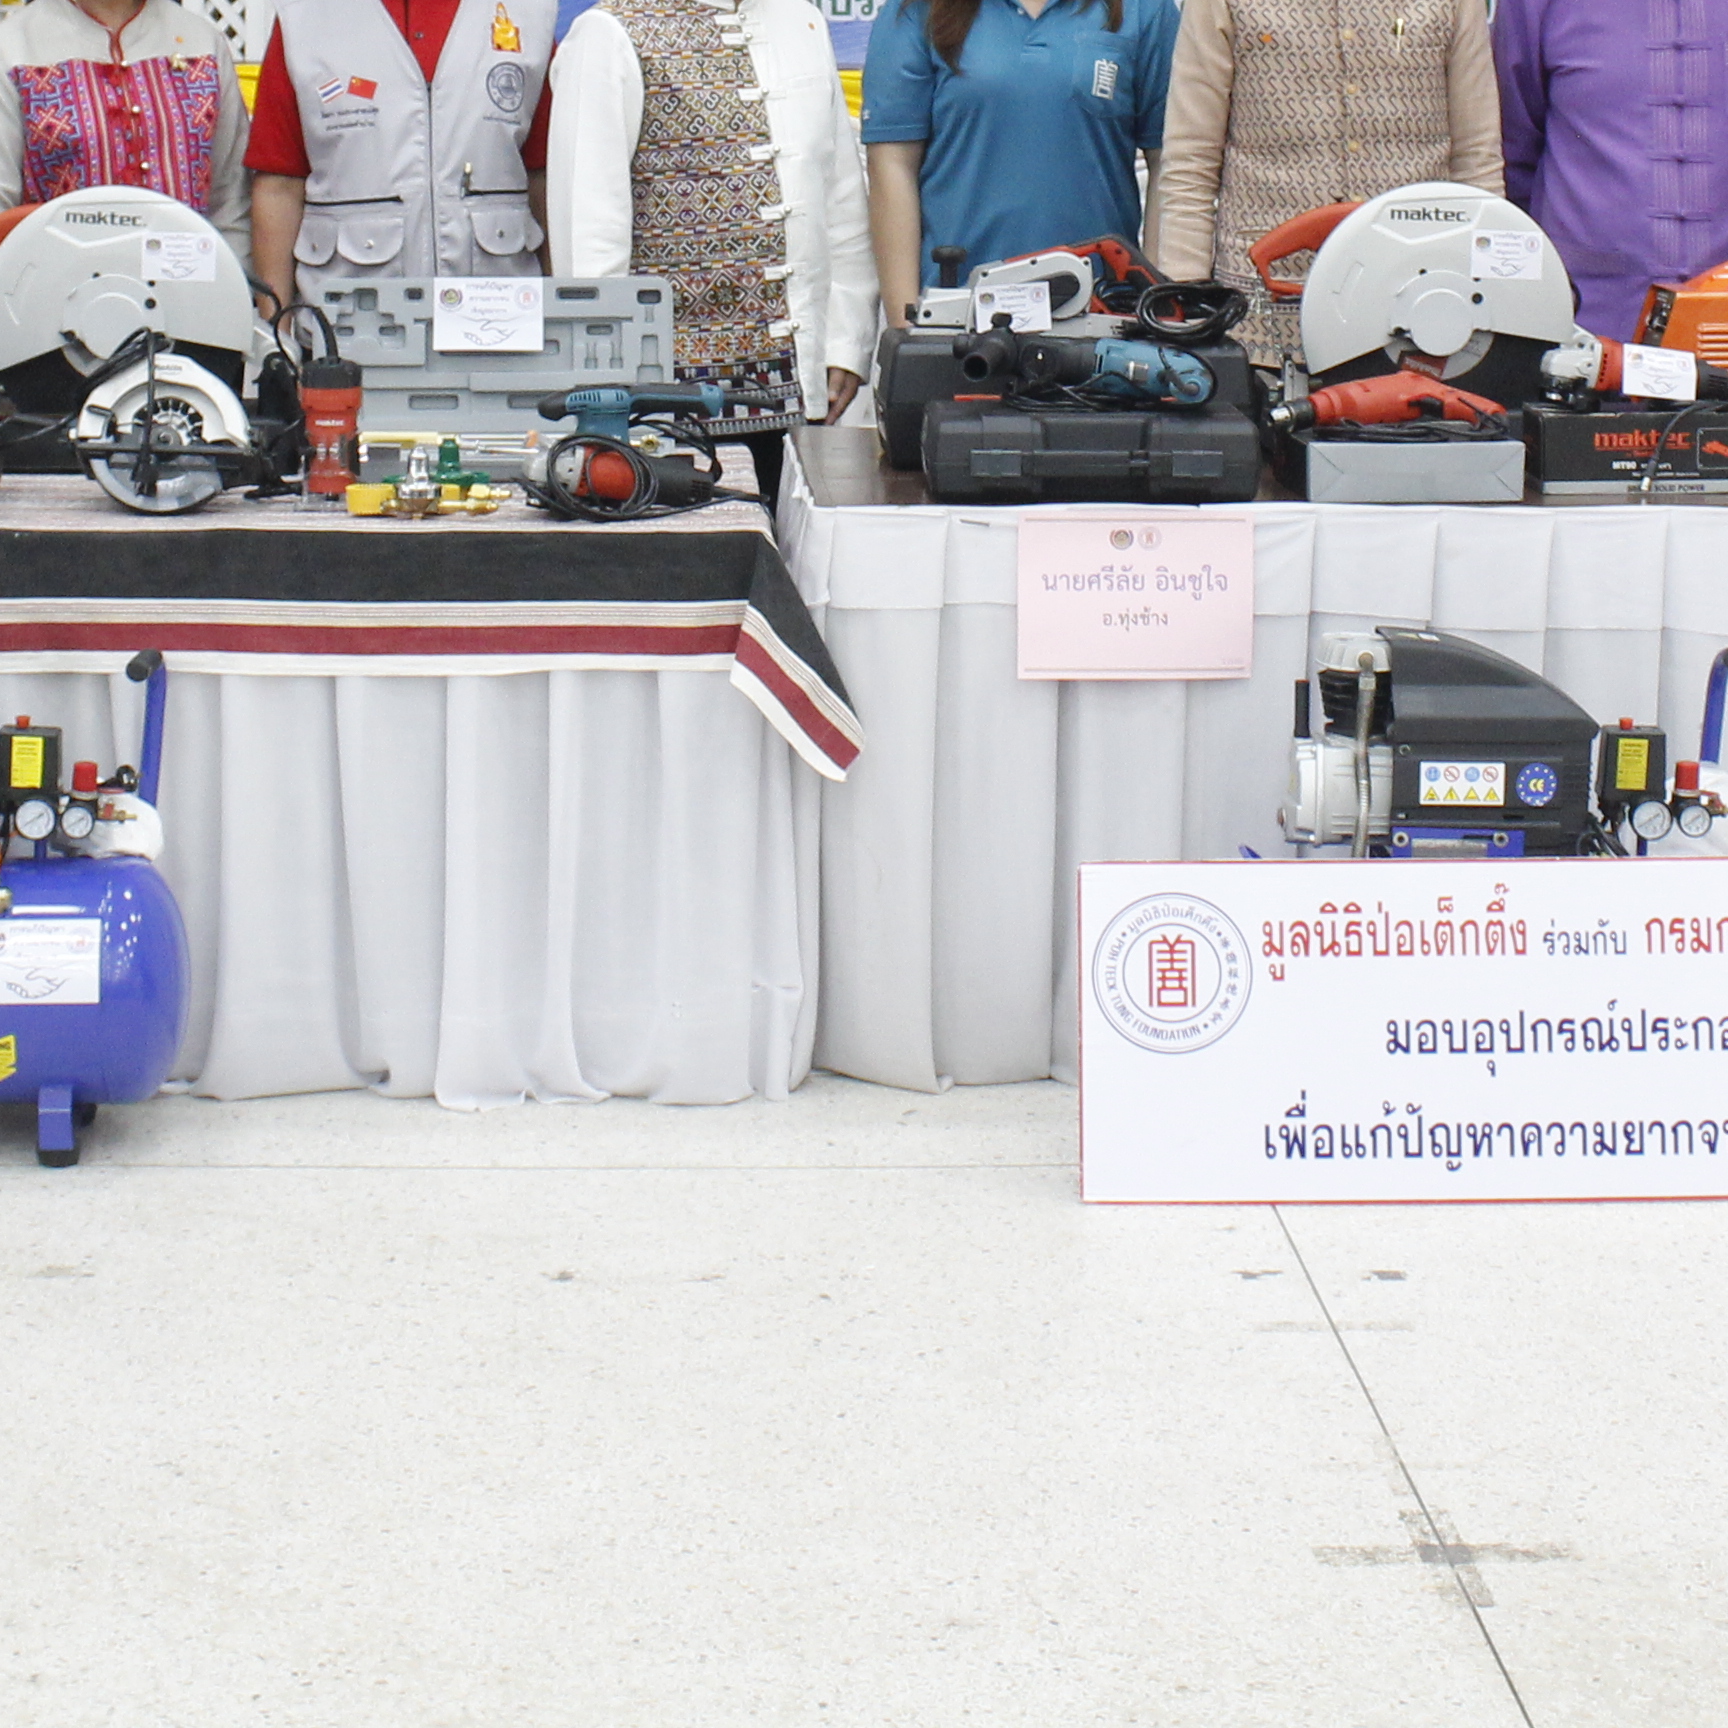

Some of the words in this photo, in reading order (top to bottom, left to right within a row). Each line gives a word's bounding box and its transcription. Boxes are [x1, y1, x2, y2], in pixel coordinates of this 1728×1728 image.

[64, 210, 148, 228] maktec
[1388, 204, 1469, 224] maktec
[1261, 882, 1528, 981] มูลนิธิป่อเต็กตึ๊ง
[1542, 918, 1628, 956] ร่วมกับ
[1131, 1018, 1202, 1041] FOUNDATION
